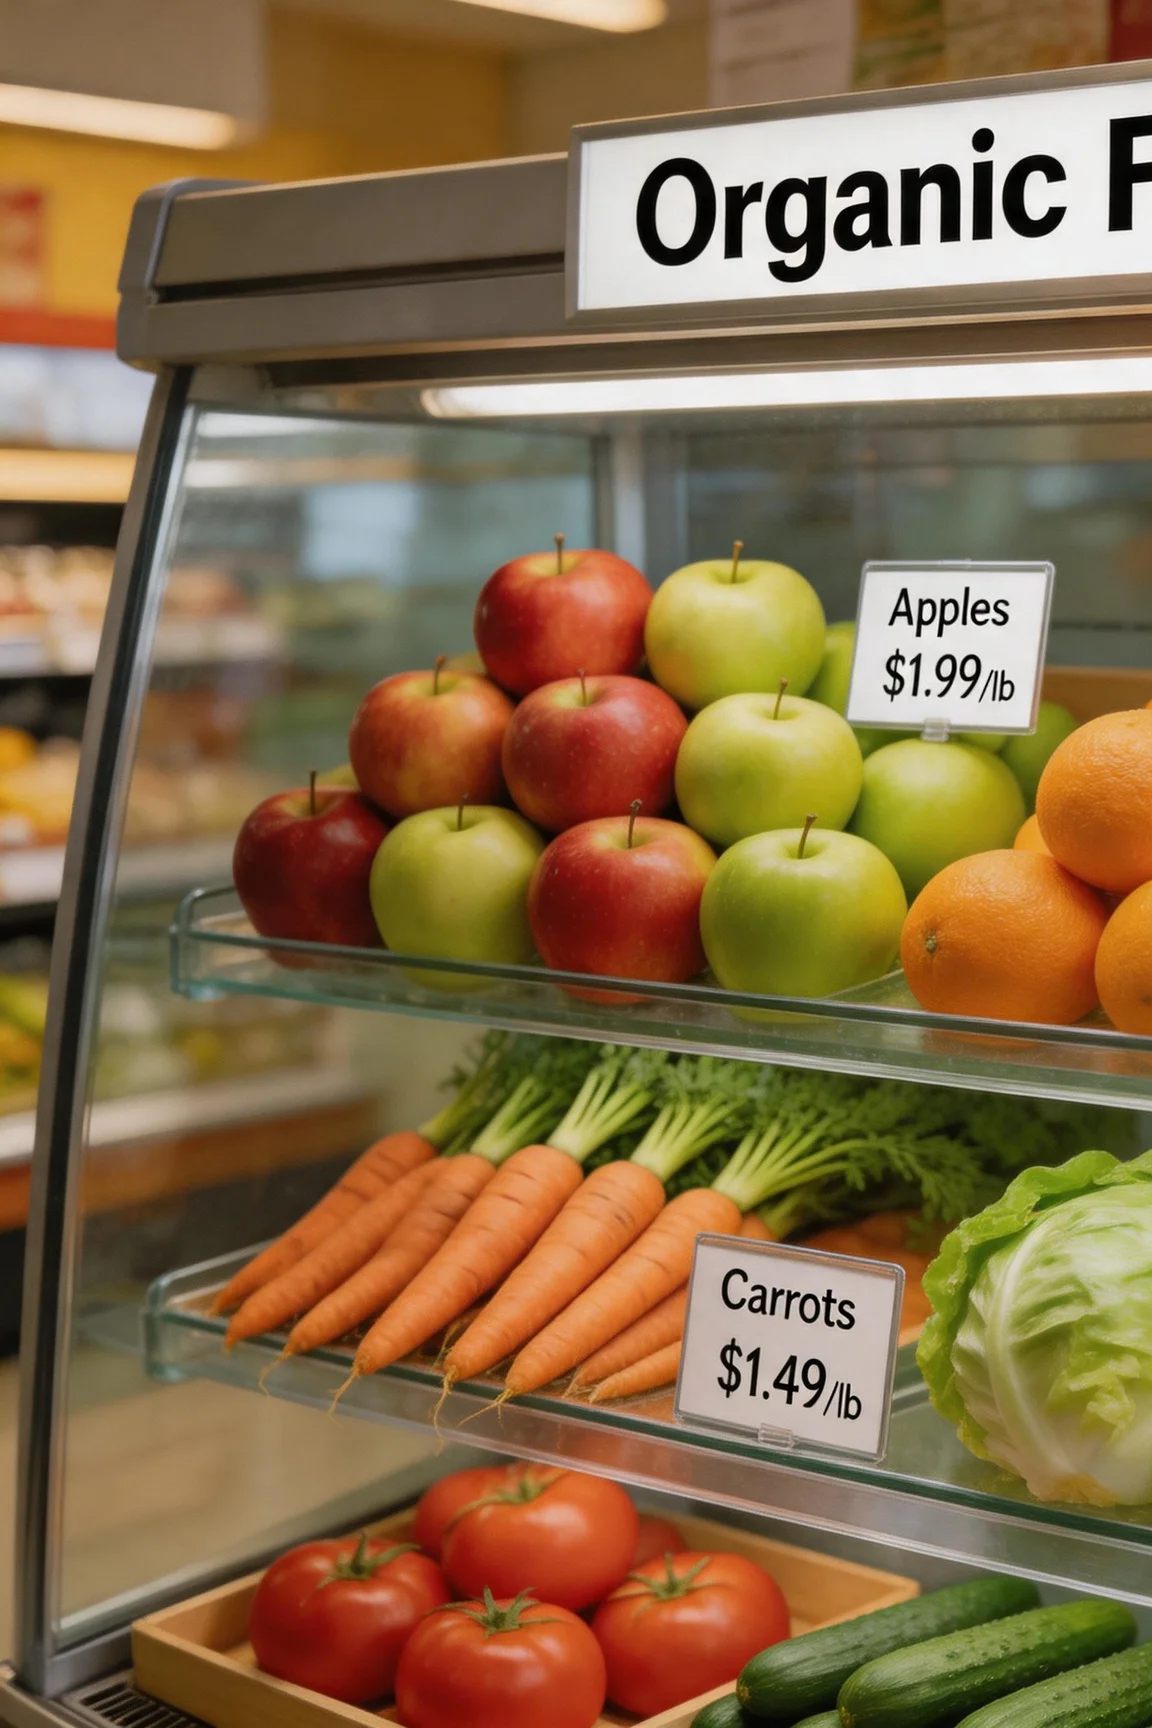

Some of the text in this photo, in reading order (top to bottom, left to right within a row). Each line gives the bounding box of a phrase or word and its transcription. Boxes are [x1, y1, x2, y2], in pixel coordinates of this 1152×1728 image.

[637, 128, 1067, 283] Organic
[887, 586, 1010, 638] Apples
[883, 648, 1015, 703] $1.99/lb
[721, 1268, 856, 1330] Carrots
[717, 1338, 862, 1420] $1.49/lb
